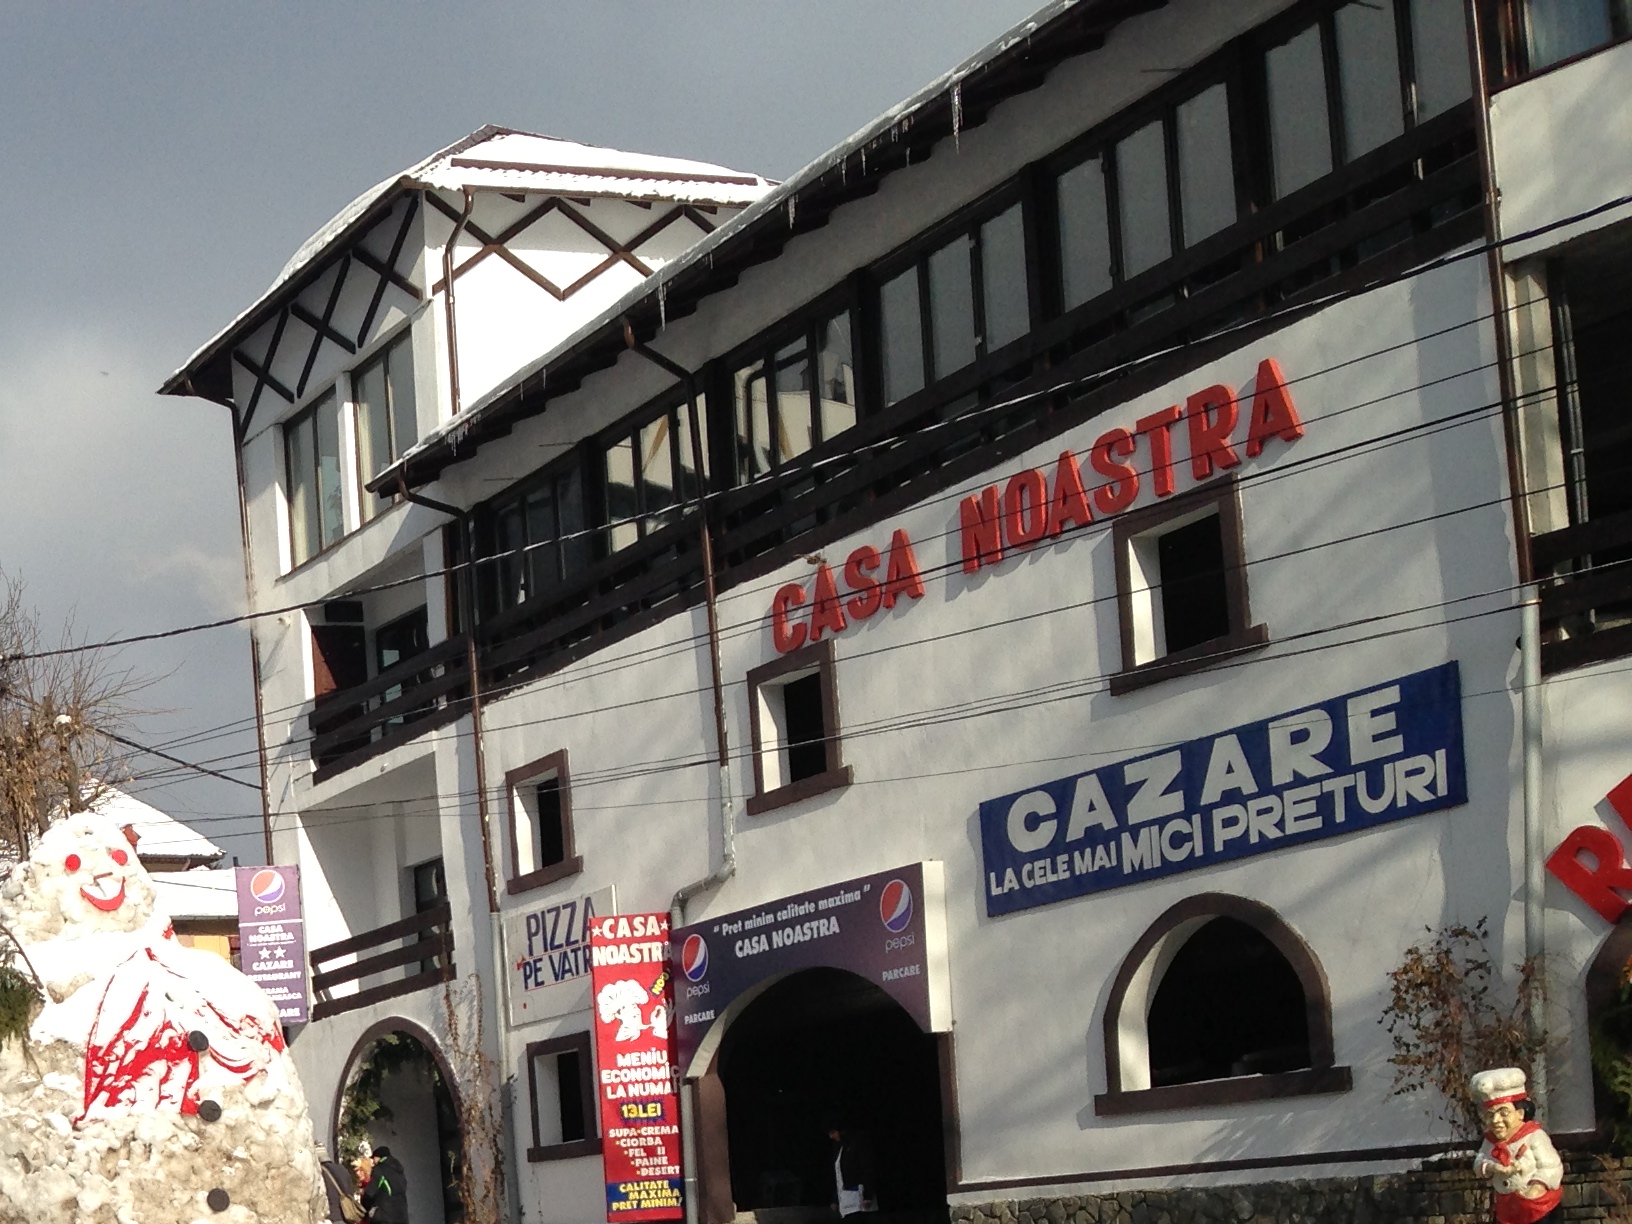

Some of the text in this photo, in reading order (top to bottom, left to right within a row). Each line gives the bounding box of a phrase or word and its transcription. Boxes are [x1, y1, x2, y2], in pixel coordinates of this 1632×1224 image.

[773, 358, 1304, 654] CASA NOASTRA
[1007, 684, 1404, 853] CAZARE
[991, 749, 1447, 897] LA CELE MAI MICI PRETURI
[254, 902, 286, 917] pepsi
[722, 890, 861, 936] Pret minim calitate maxima
[258, 925, 284, 934] CASA
[526, 896, 596, 957] PIZZA
[602, 916, 660, 939] CASA
[248, 932, 295, 942] NOASTRA
[735, 916, 841, 958] CASA NOASTRA
[885, 932, 915, 953] pepsi
[592, 941, 672, 967] NOASTRA
[252, 960, 294, 971] CAZARE
[523, 944, 593, 990] PE VATR
[882, 963, 921, 981] PARCARE
[686, 981, 710, 999] pepsi
[684, 1009, 716, 1025] PARCARE
[607, 1085, 626, 1099] LA
[620, 1137, 663, 1147] CIORBA
[635, 1156, 668, 1167] PAINE
[640, 1165, 680, 1176] DESERT
[619, 1180, 669, 1193] CALITATE
[628, 1188, 681, 1200] MAXIMA
[612, 1200, 637, 1211] PRET
